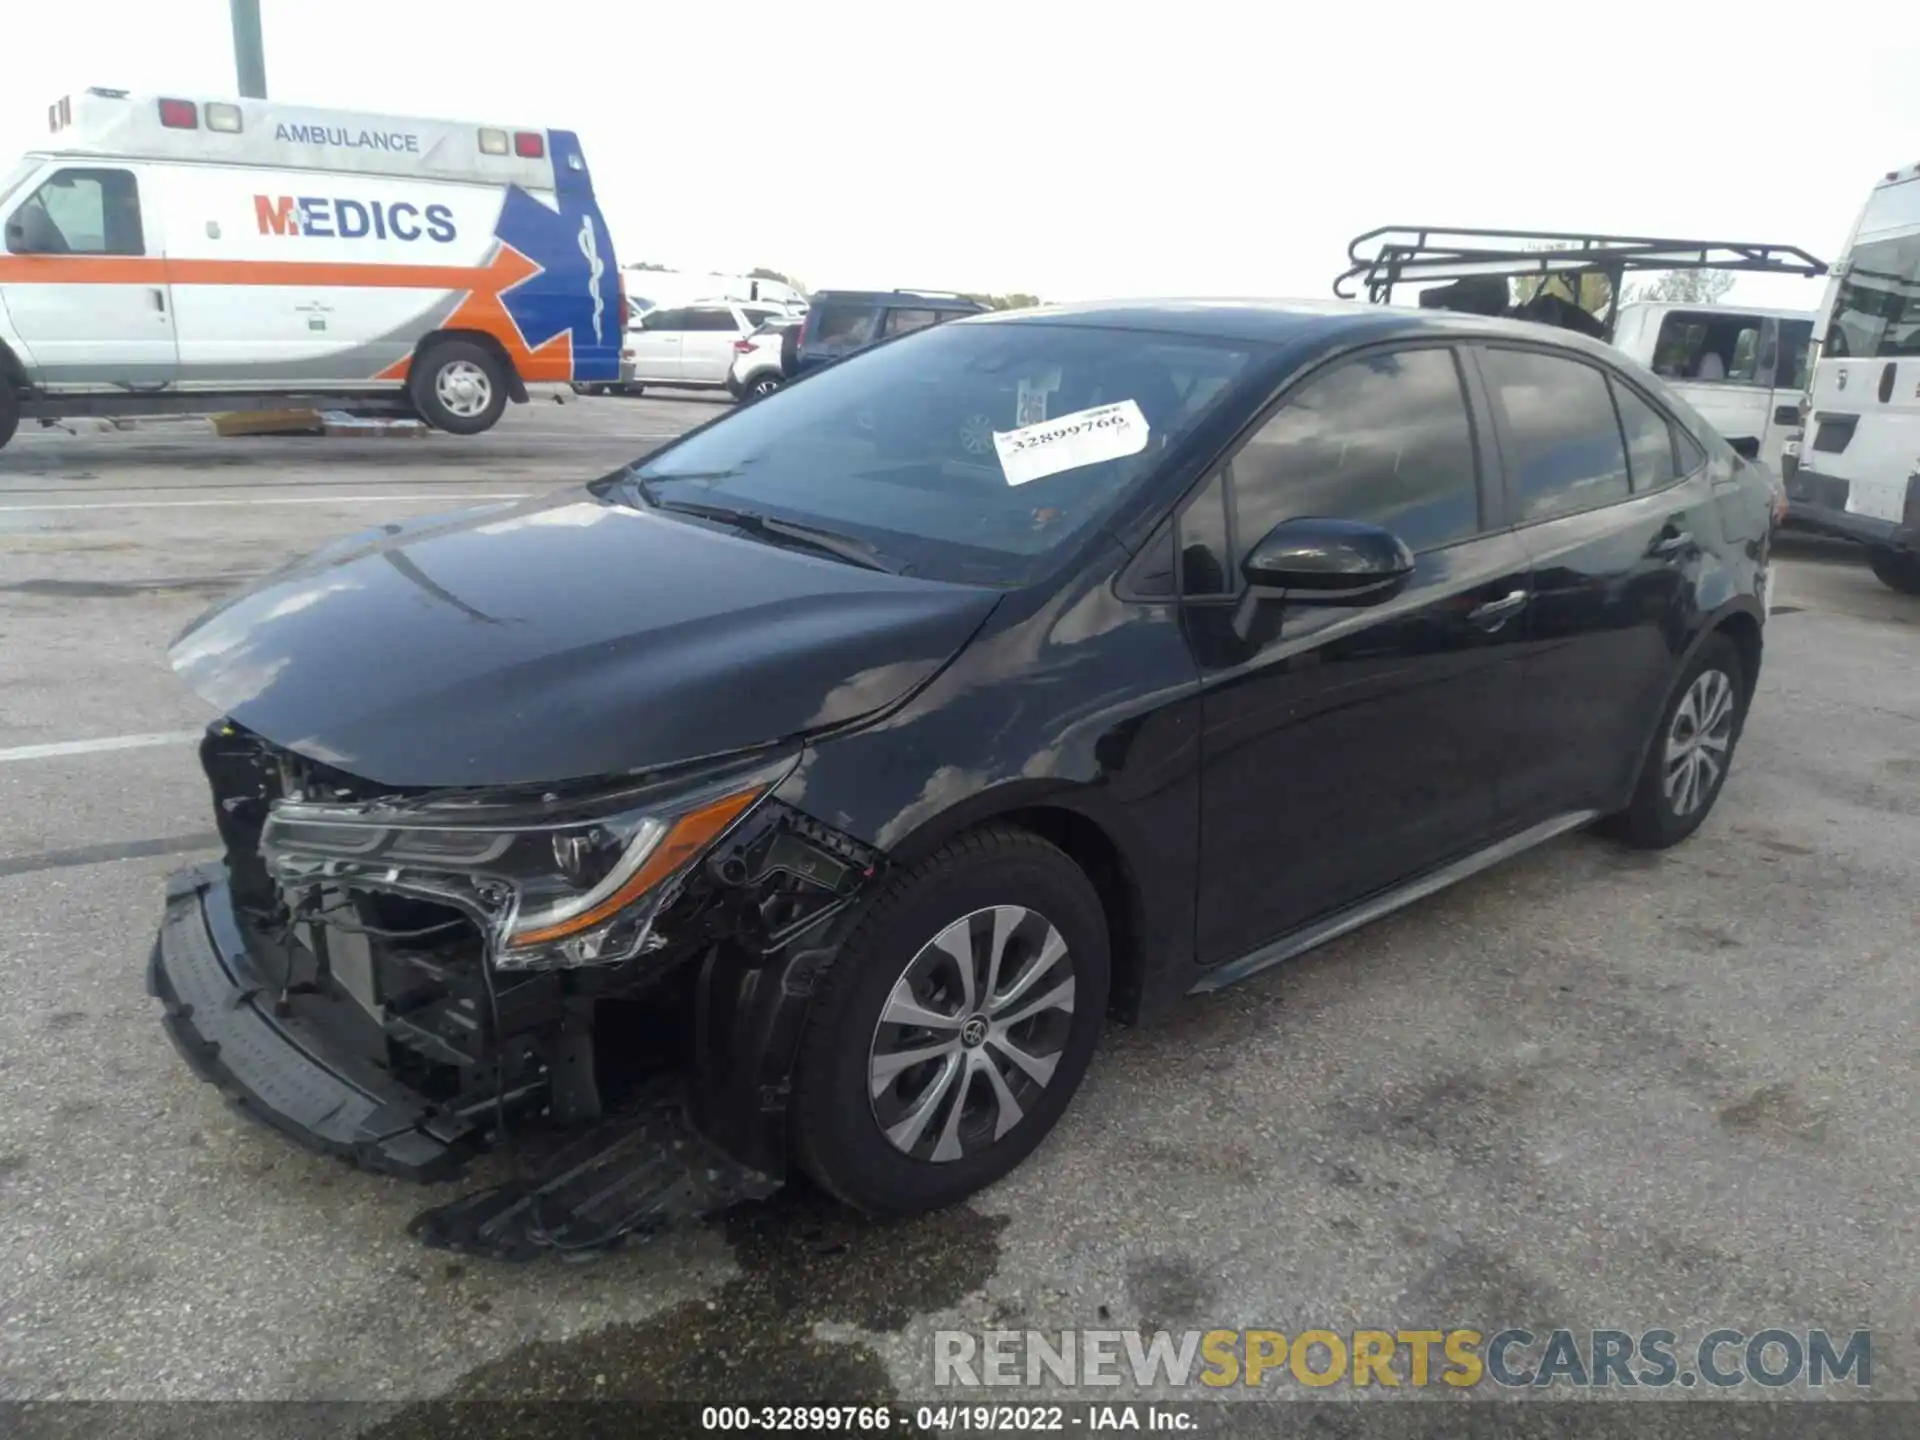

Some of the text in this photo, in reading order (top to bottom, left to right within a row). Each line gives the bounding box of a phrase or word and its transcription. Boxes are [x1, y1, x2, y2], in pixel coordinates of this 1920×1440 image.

[275, 123, 419, 153] AMBULANCE
[254, 194, 457, 243] MEDICS
[1013, 415, 1125, 453] 32899766
